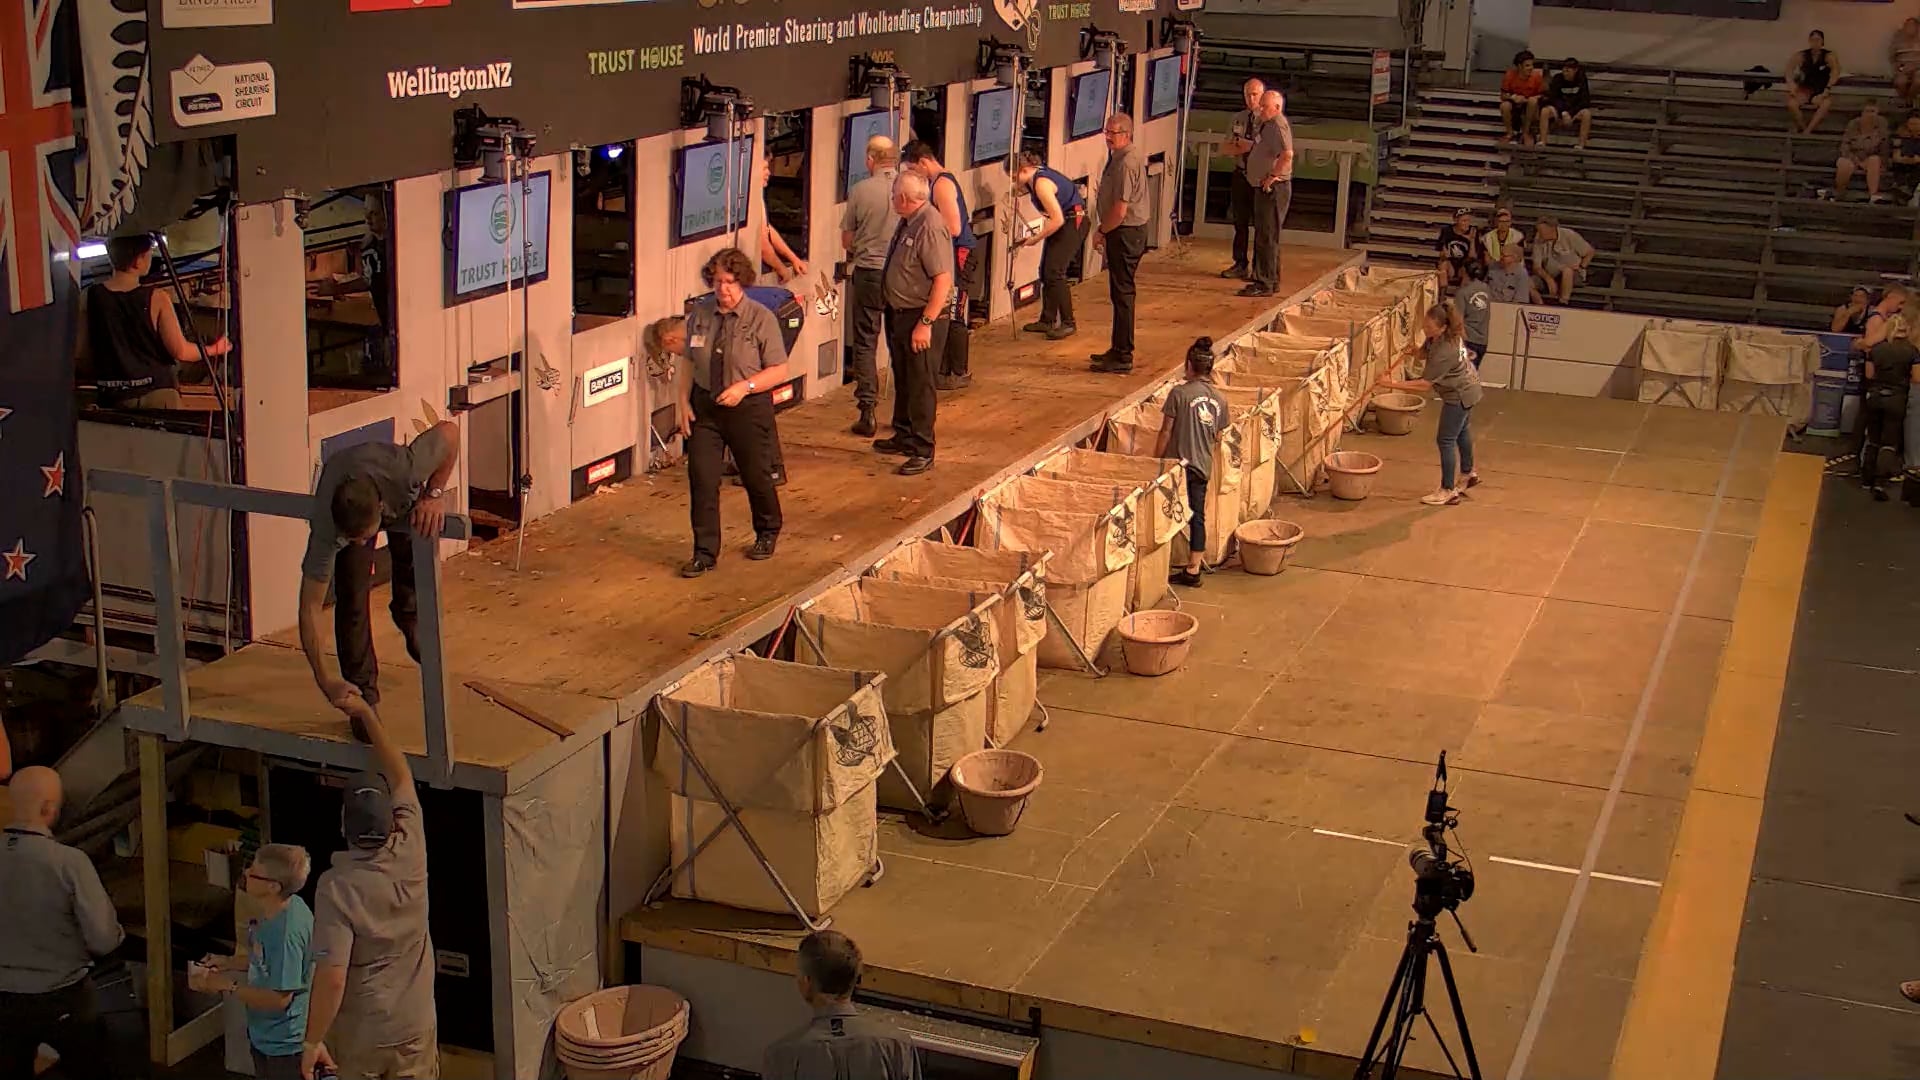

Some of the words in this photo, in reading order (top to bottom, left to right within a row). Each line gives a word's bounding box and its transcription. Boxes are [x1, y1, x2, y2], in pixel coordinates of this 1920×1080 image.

[1048, 4, 1068, 20] TRUST
[1070, 3, 1091, 18] HOUSE
[694, 25, 730, 54] World
[736, 22, 780, 49] Premier
[785, 17, 834, 44] Shearing
[836, 14, 855, 38] and
[858, 8, 921, 33] Woolhandling
[923, 3, 982, 30] Championship
[588, 49, 635, 75] TRUST
[640, 44, 684, 69] HOUSE
[234, 72, 269, 84] NATIONAL
[387, 62, 512, 99] WellingtonNZ
[235, 84, 270, 97] SHEARING
[235, 97, 263, 109] CIRCUIT
[461, 262, 498, 286] TRUST
[1528, 313, 1559, 324] NOTICE
[590, 372, 622, 391] BAYLEYS
